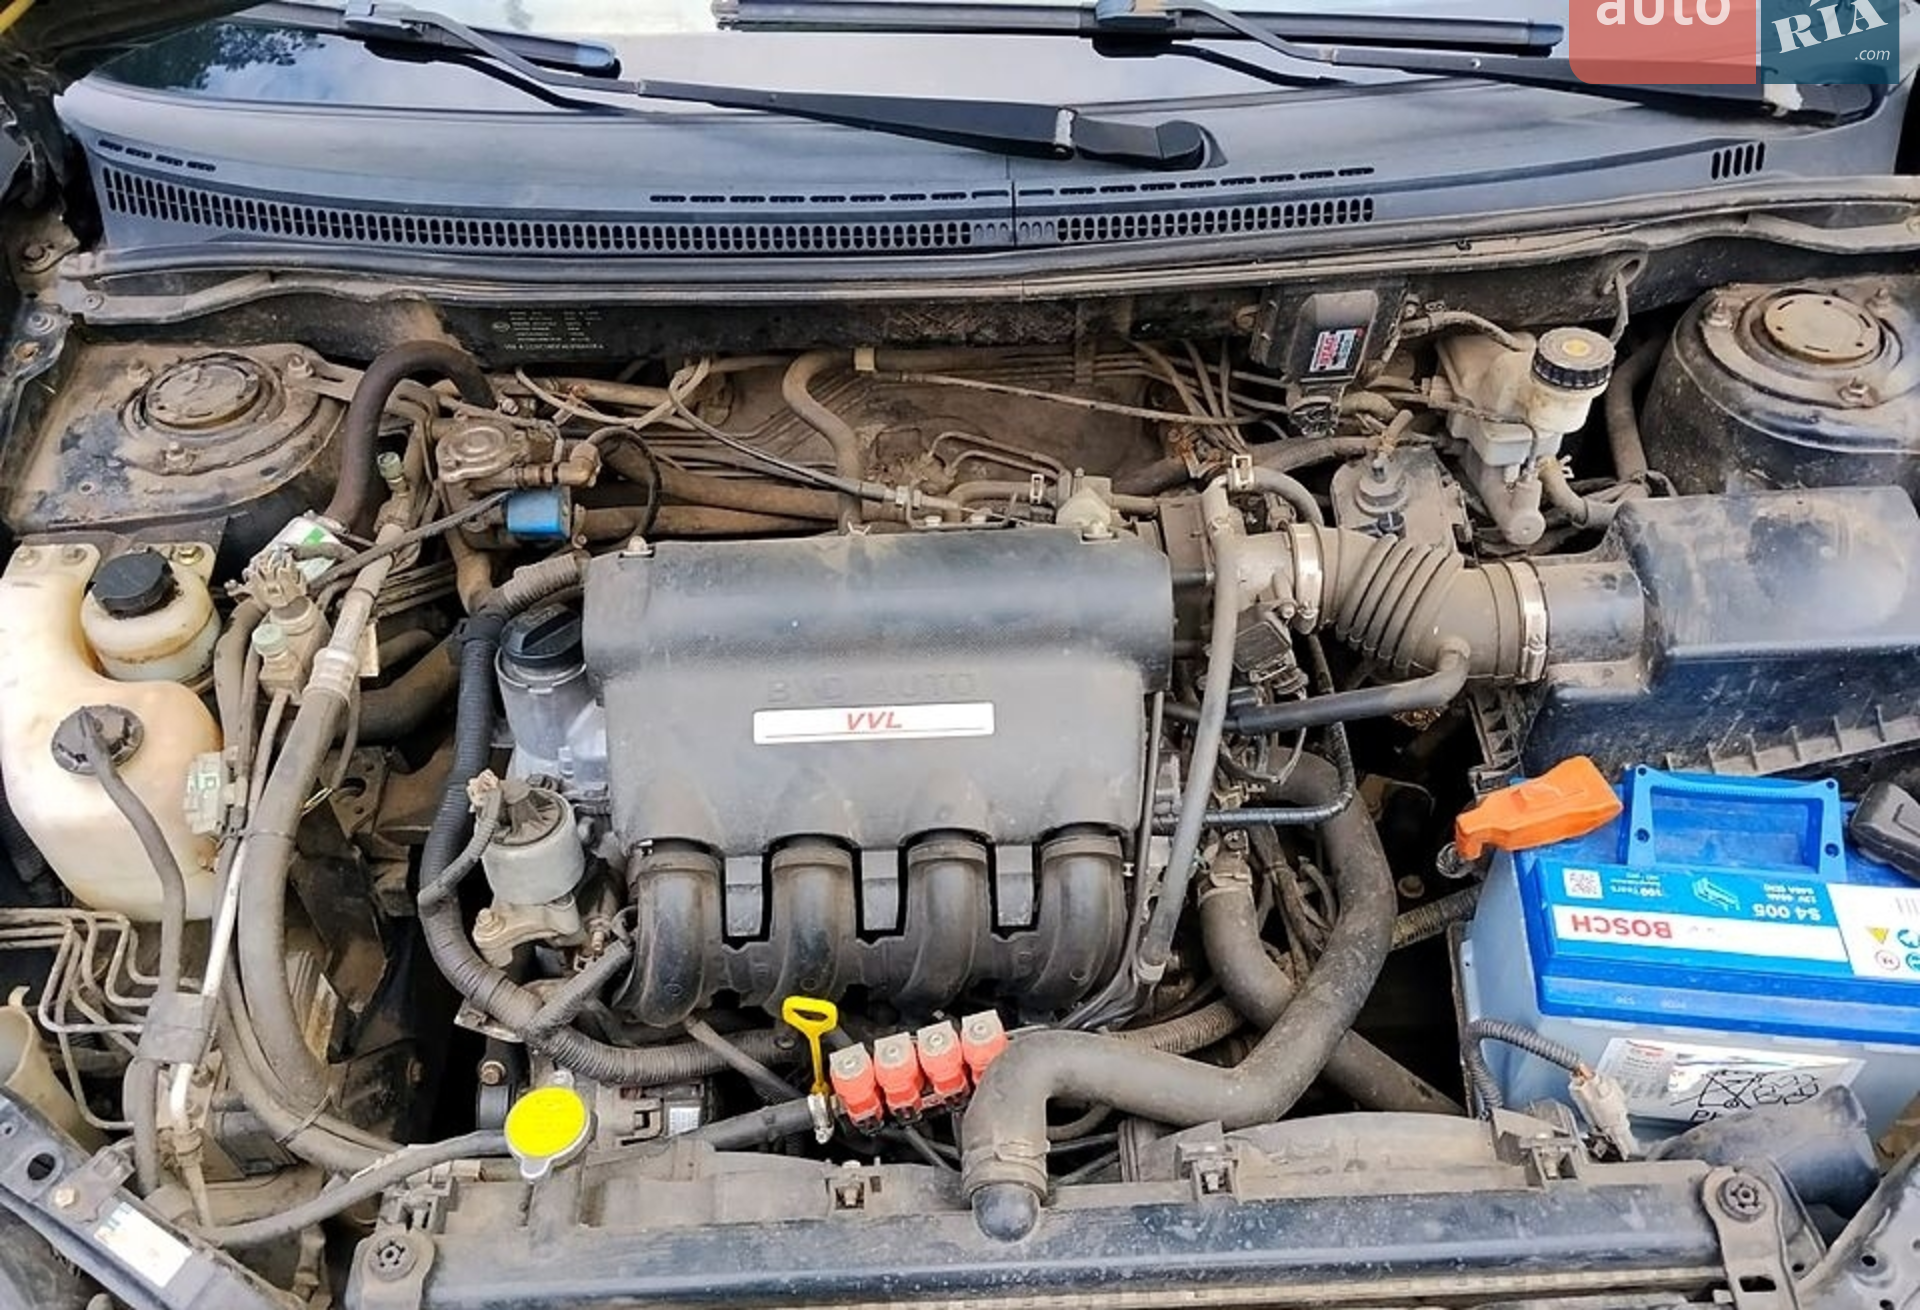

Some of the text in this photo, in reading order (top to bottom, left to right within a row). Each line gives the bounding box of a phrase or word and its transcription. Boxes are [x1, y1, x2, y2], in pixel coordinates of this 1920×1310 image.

[868, 673, 976, 698] AUTO
[847, 711, 903, 731] VVL
[1752, 903, 1822, 921] S4 005
[1571, 913, 1673, 939] BOSCH
